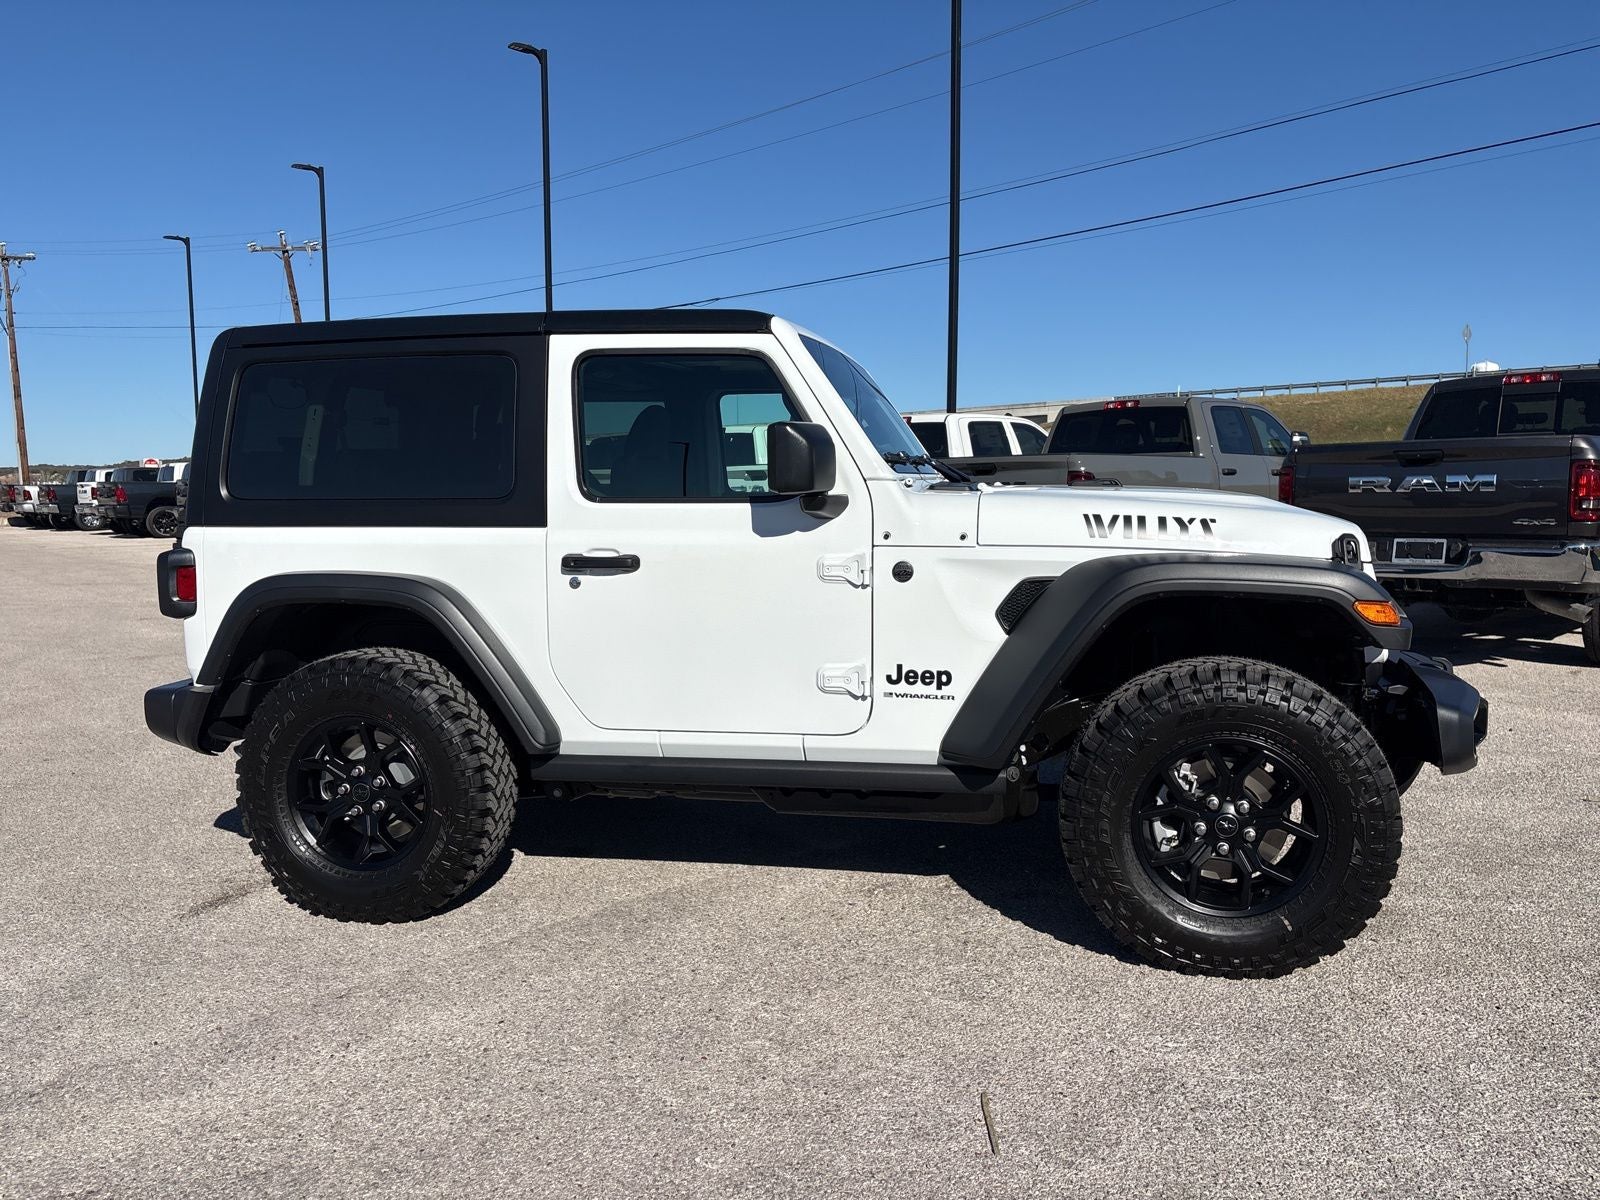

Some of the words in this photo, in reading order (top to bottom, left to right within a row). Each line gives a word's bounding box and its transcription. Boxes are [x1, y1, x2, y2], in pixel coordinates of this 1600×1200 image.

[1348, 474, 1497, 493] RAM
[1082, 513, 1217, 540] WILLYS
[885, 663, 953, 690] Jeep
[894, 692, 956, 701] WRANGLER
